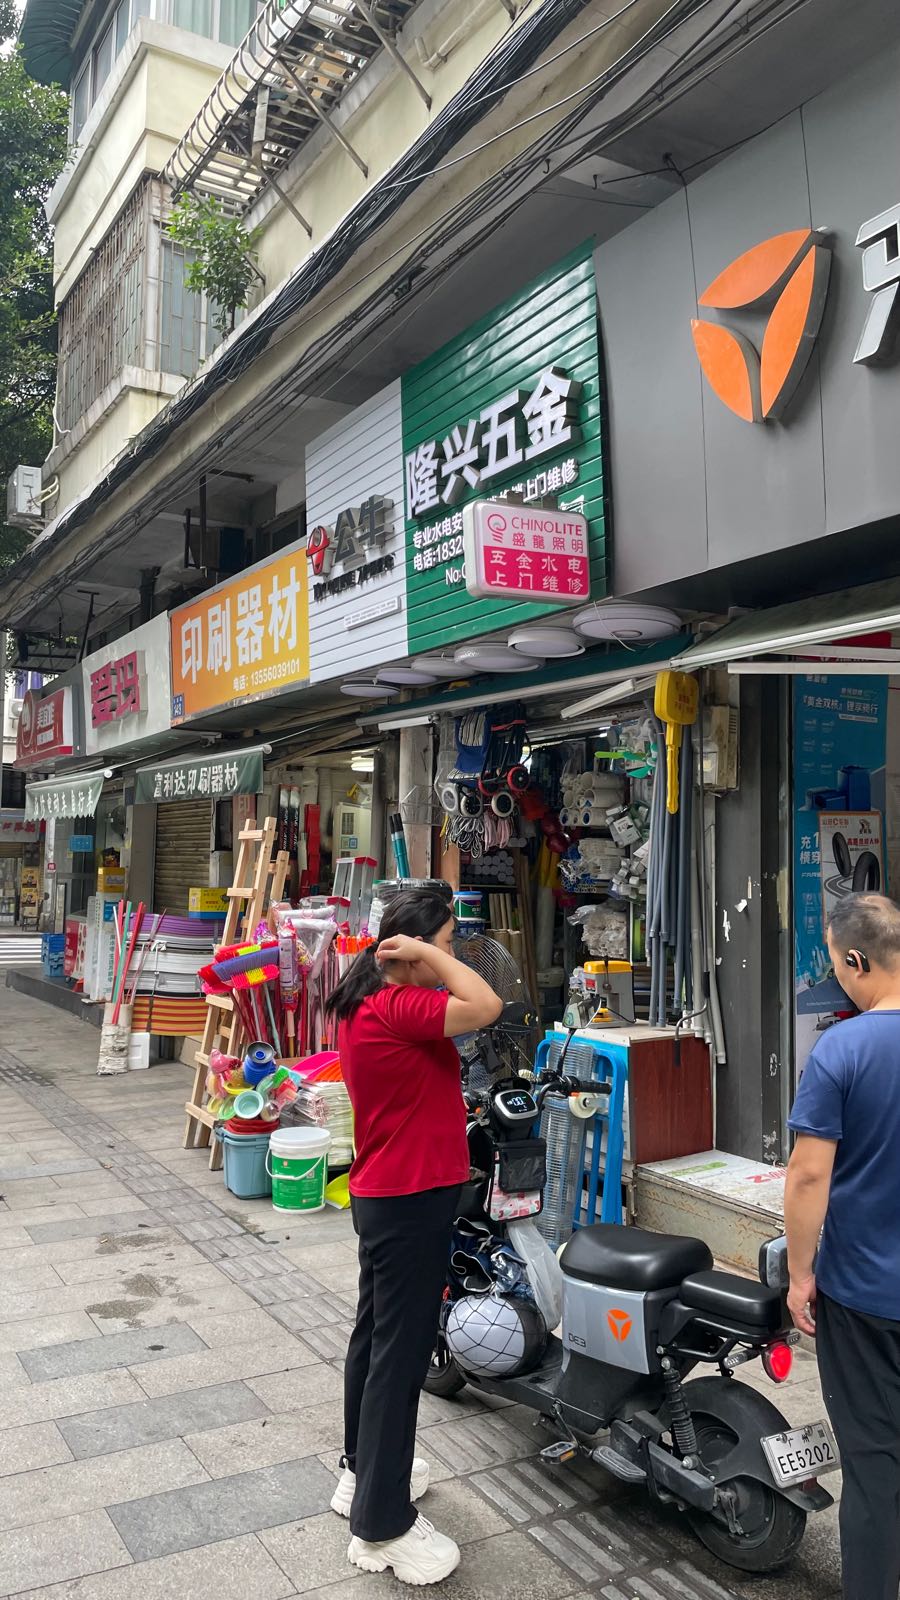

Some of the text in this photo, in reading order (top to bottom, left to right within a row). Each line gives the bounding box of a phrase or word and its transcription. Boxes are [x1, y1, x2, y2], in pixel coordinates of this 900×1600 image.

[405, 367, 572, 520] 隆兴五金
[335, 495, 388, 564] 公牛
[511, 517, 583, 536] CHINOLITE
[512, 532, 584, 554] 盛龍照明
[490, 550, 584, 575] 五金水电
[490, 570, 584, 594] 上门维修
[181, 566, 301, 685] 印刷器材
[250, 658, 301, 687] 13556039101
[153, 761, 239, 798] 富利达印刷器材
[777, 1442, 834, 1475] EE5202
